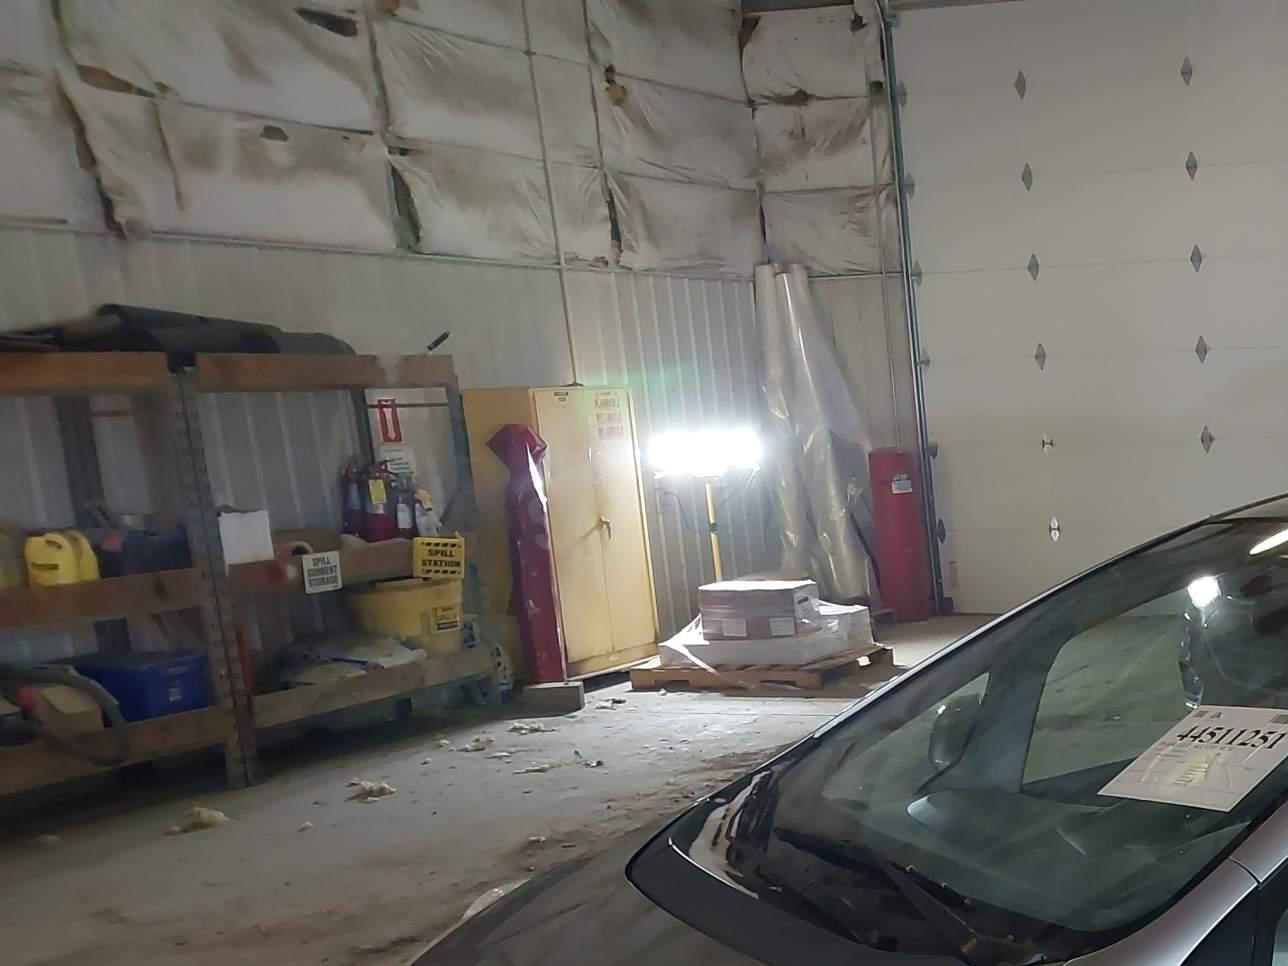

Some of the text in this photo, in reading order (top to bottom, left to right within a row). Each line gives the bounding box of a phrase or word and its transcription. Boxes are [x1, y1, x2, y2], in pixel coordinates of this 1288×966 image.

[428, 549, 455, 558] SPILL
[312, 556, 330, 567] SPILL
[421, 559, 461, 568] STATION
[1177, 725, 1288, 749] 44511251
